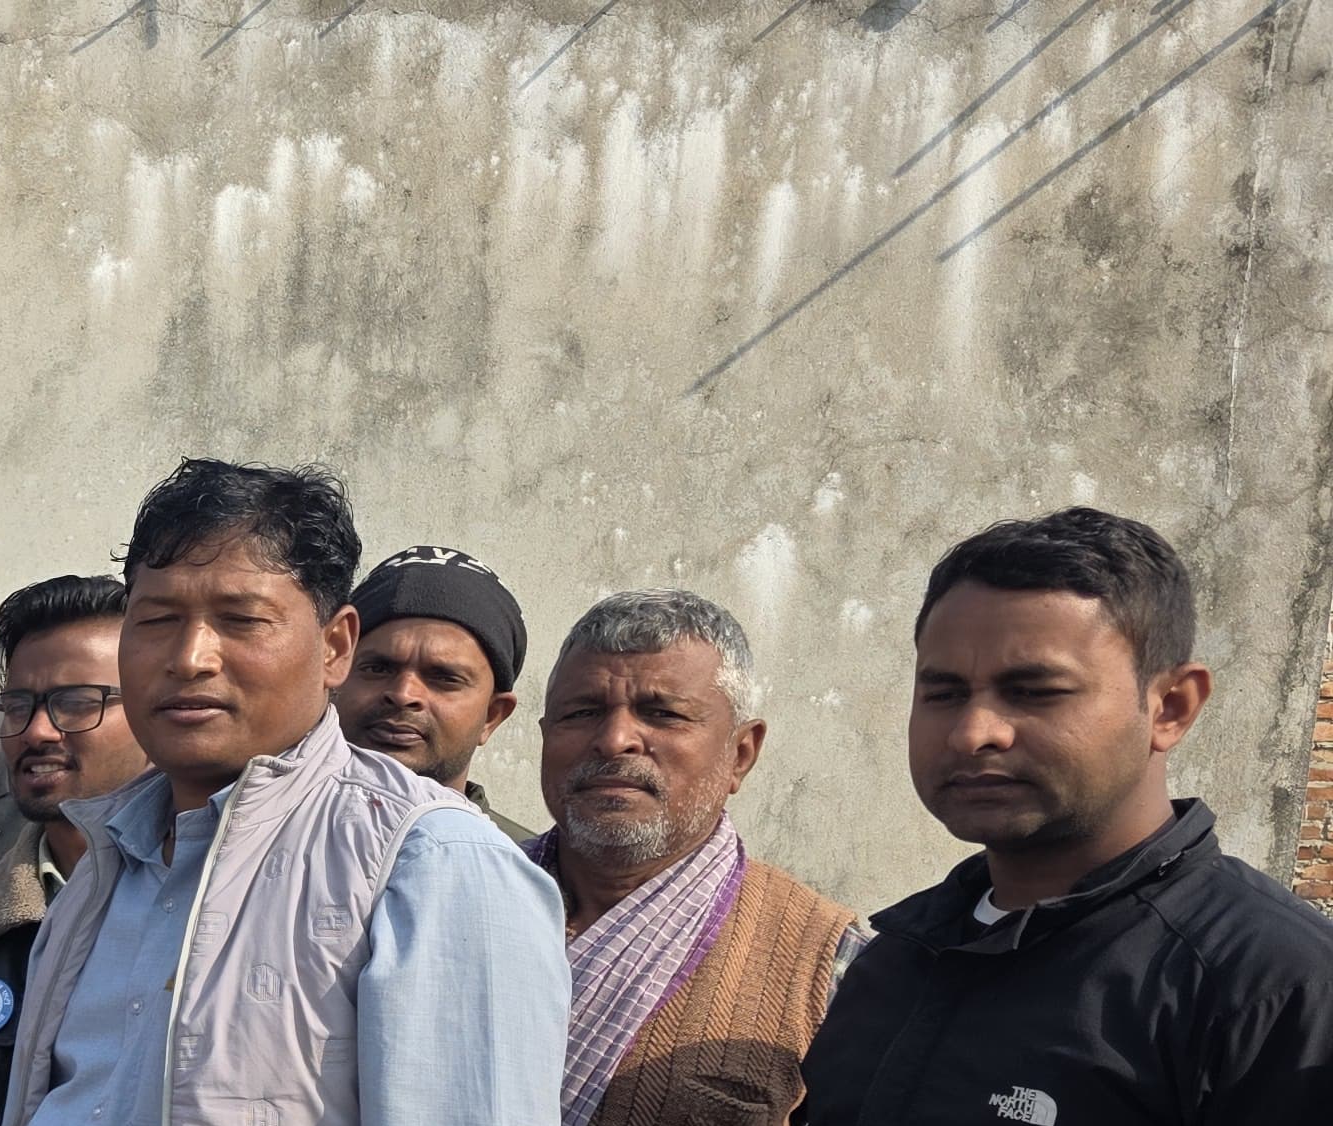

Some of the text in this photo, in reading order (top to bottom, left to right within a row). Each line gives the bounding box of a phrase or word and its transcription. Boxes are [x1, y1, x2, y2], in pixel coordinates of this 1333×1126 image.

[1012, 1085, 1037, 1100] THE
[988, 1093, 1034, 1116] NORTH
[997, 1106, 1032, 1122] FACE
